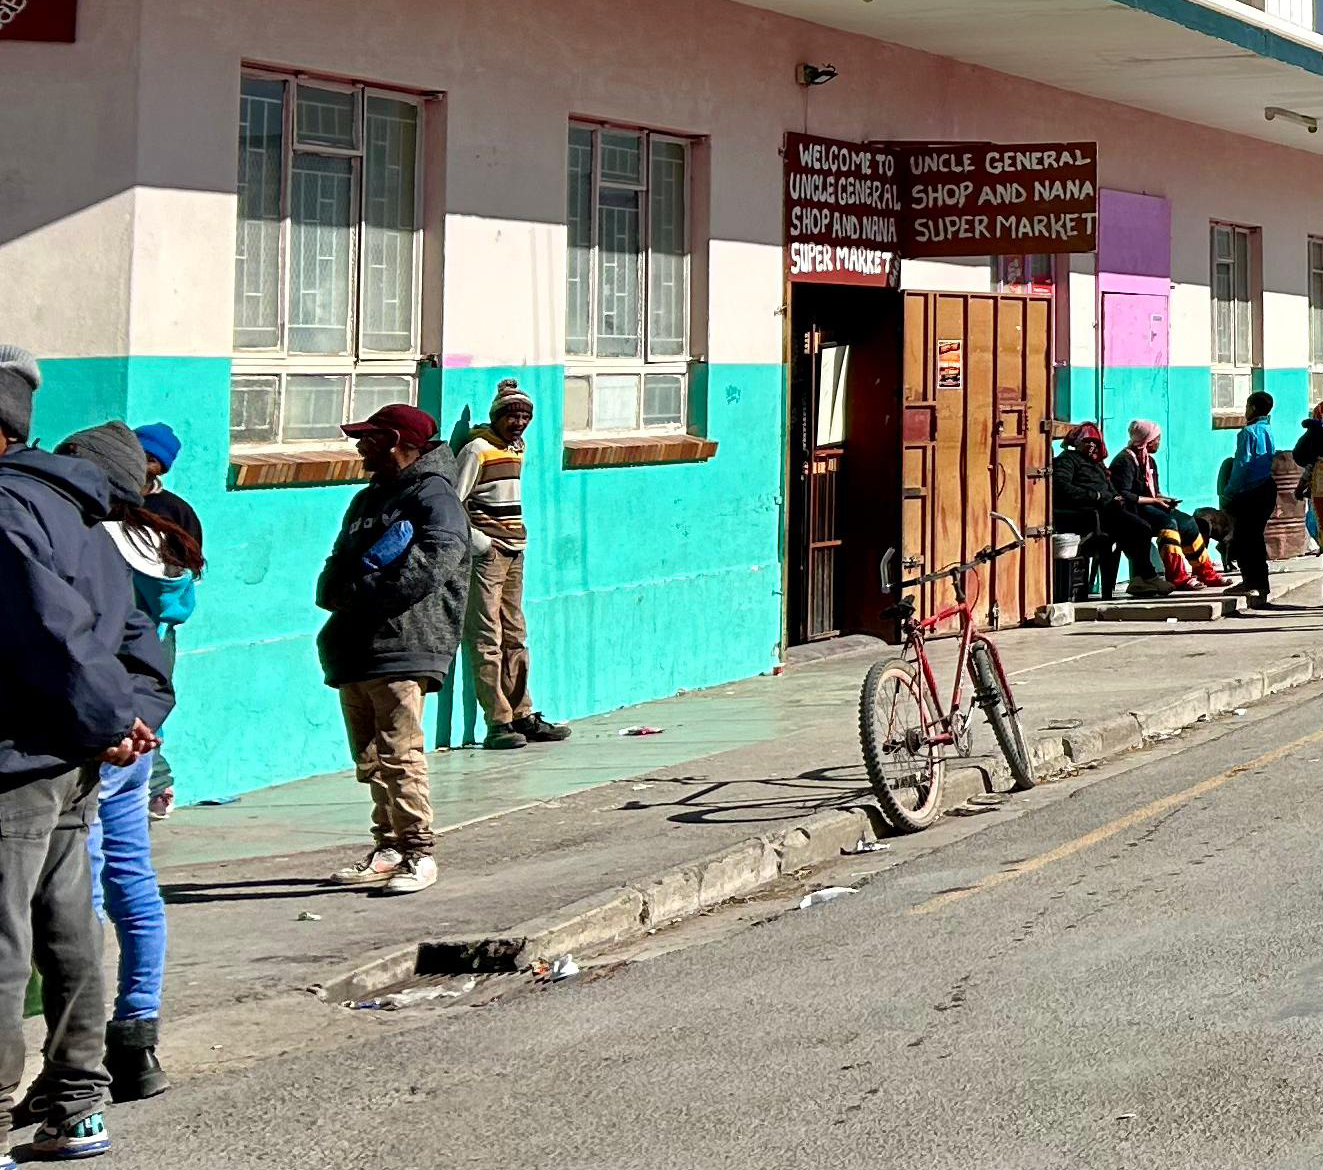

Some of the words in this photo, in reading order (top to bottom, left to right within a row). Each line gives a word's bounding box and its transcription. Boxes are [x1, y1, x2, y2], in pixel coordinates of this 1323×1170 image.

[799, 142, 872, 174] WELCOME
[875, 153, 894, 177] TO
[910, 153, 975, 174] UNCLE
[985, 149, 1092, 174] GENERAL
[789, 172, 836, 204] UNCLE
[838, 176, 901, 210] GENERAL
[911, 181, 974, 209] SHOP
[977, 182, 1027, 205] AND
[1034, 179, 1094, 201] NANA
[790, 206, 830, 236] SHOP
[832, 211, 860, 240] AND
[862, 215, 897, 242] NANA
[914, 216, 991, 242] SUPER
[996, 212, 1097, 240] MARKET
[790, 241, 833, 274] SUPER
[835, 245, 892, 276] MARKET
